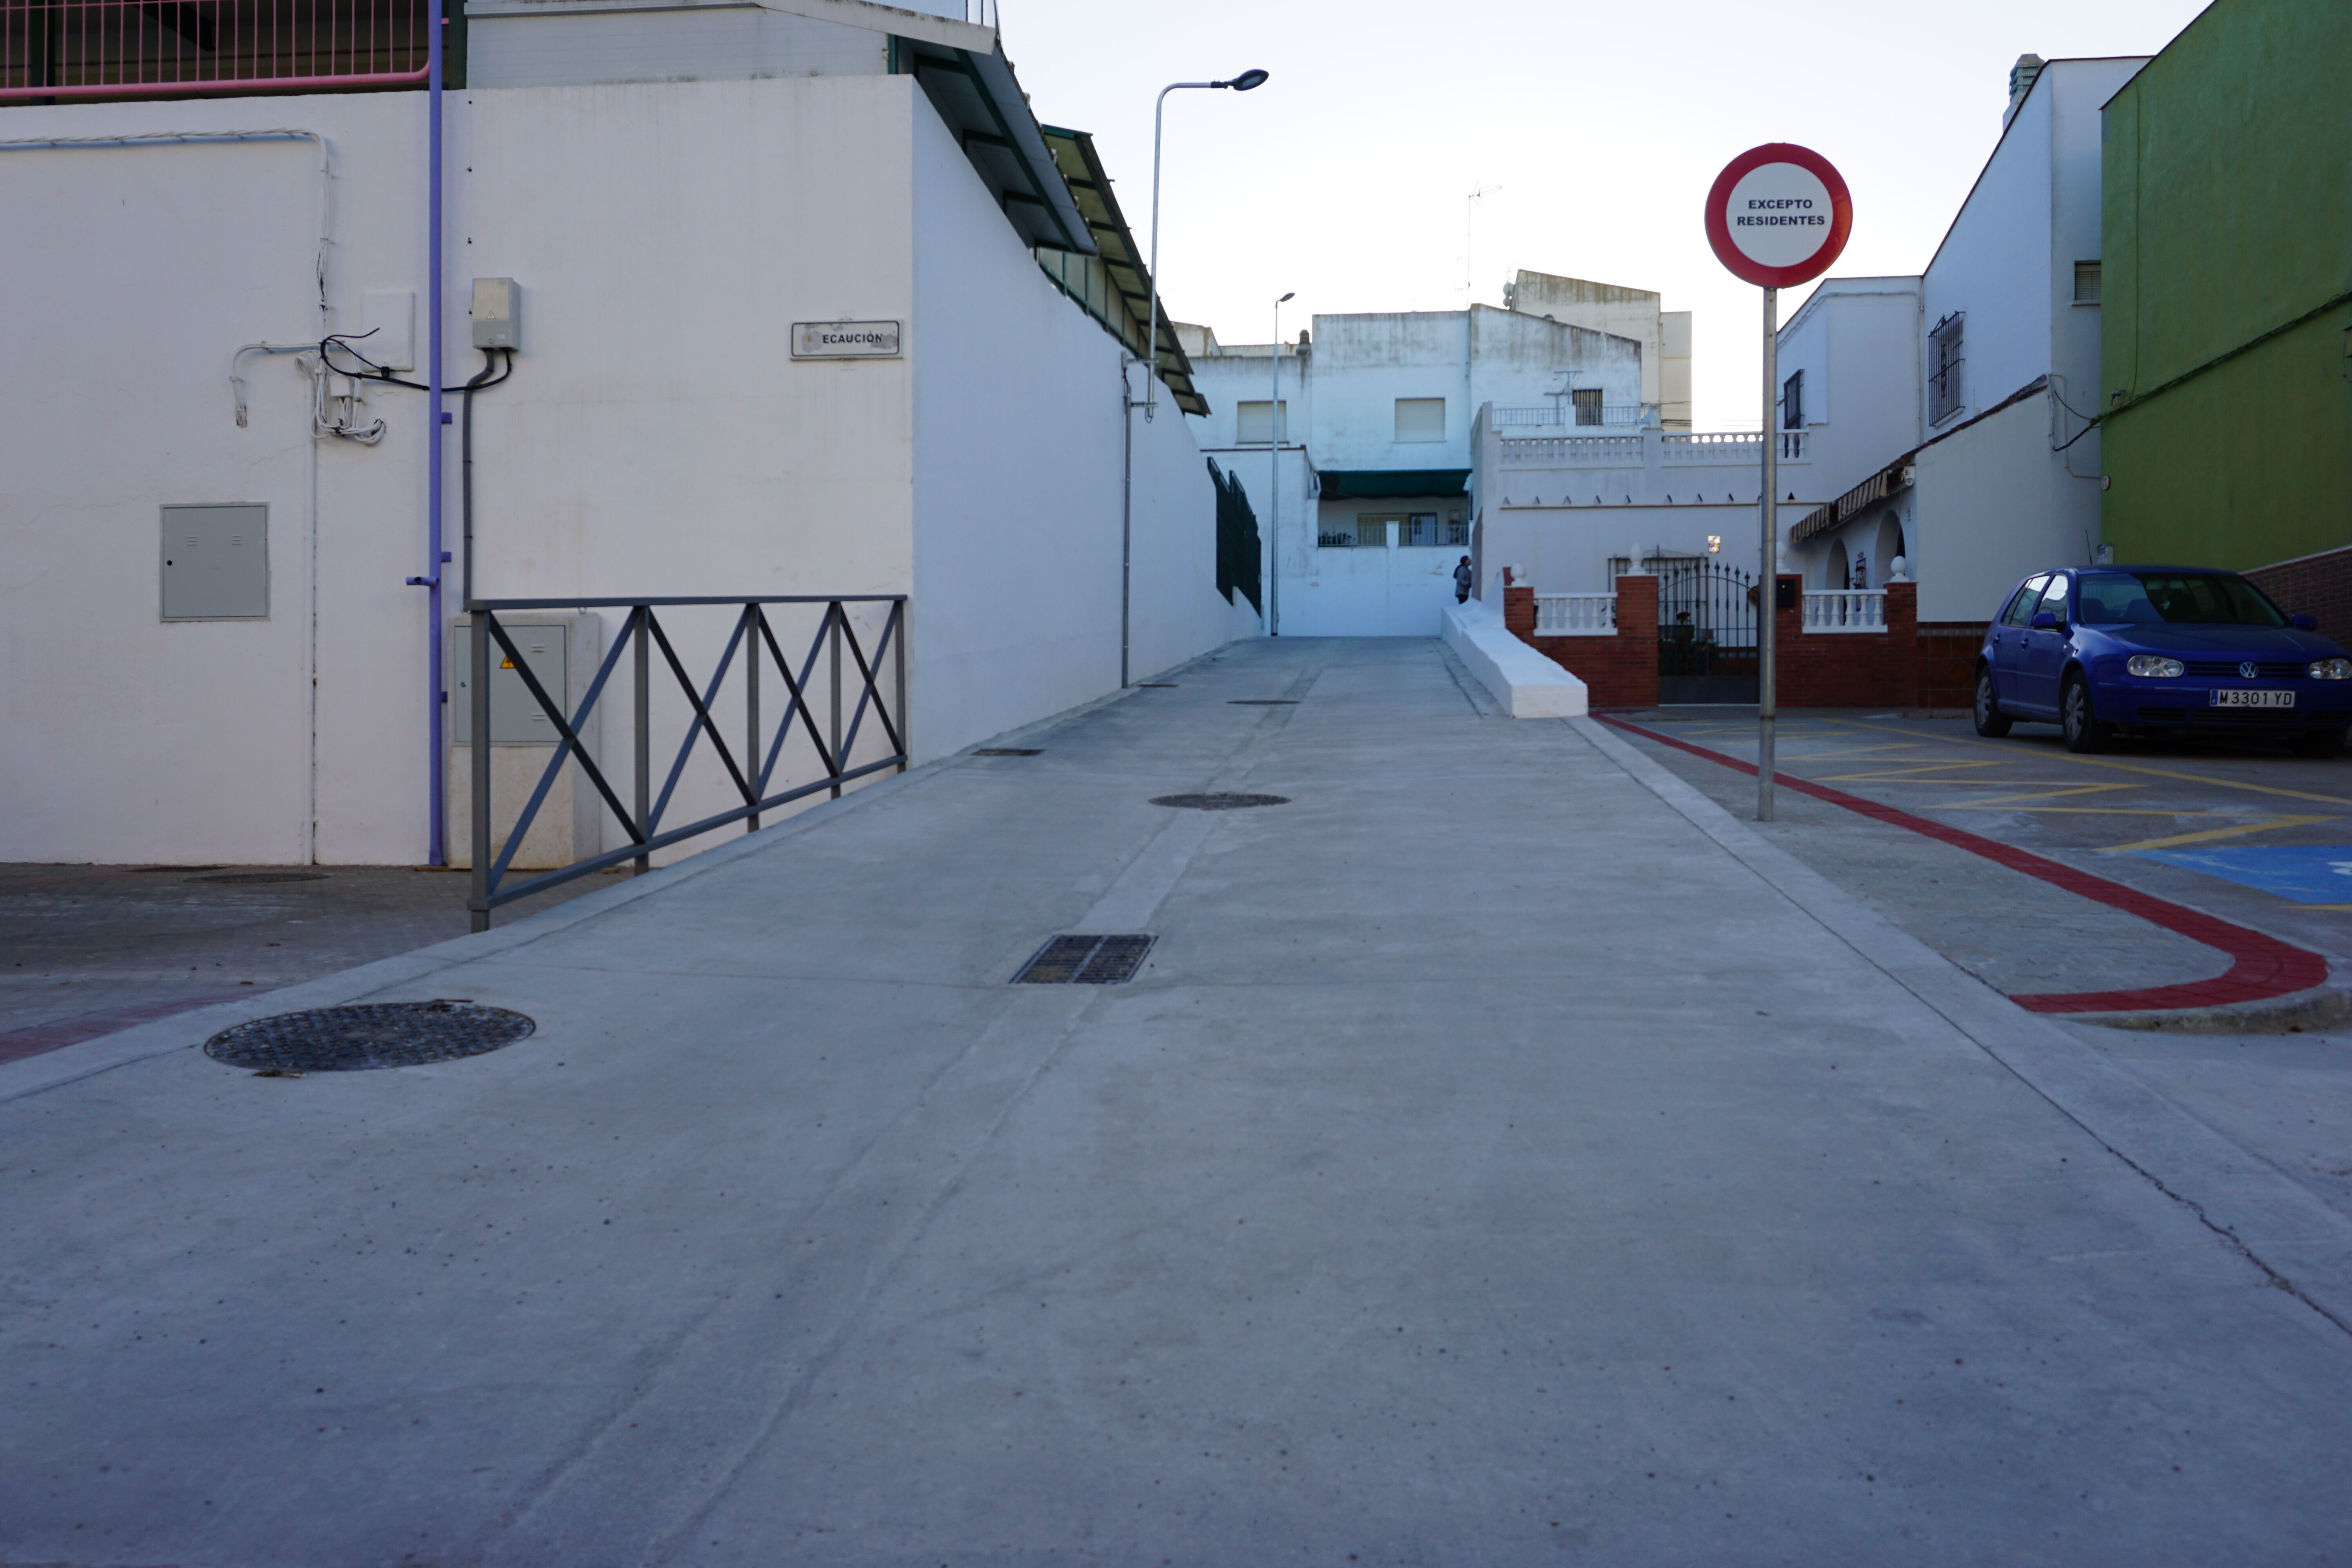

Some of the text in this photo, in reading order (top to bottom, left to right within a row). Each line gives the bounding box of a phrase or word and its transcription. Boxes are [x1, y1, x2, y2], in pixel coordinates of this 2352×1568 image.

[1748, 200, 1813, 209] EXCEPTO
[1737, 216, 1825, 226] RESIDENTES
[2220, 691, 2292, 705] M 3301 YD
